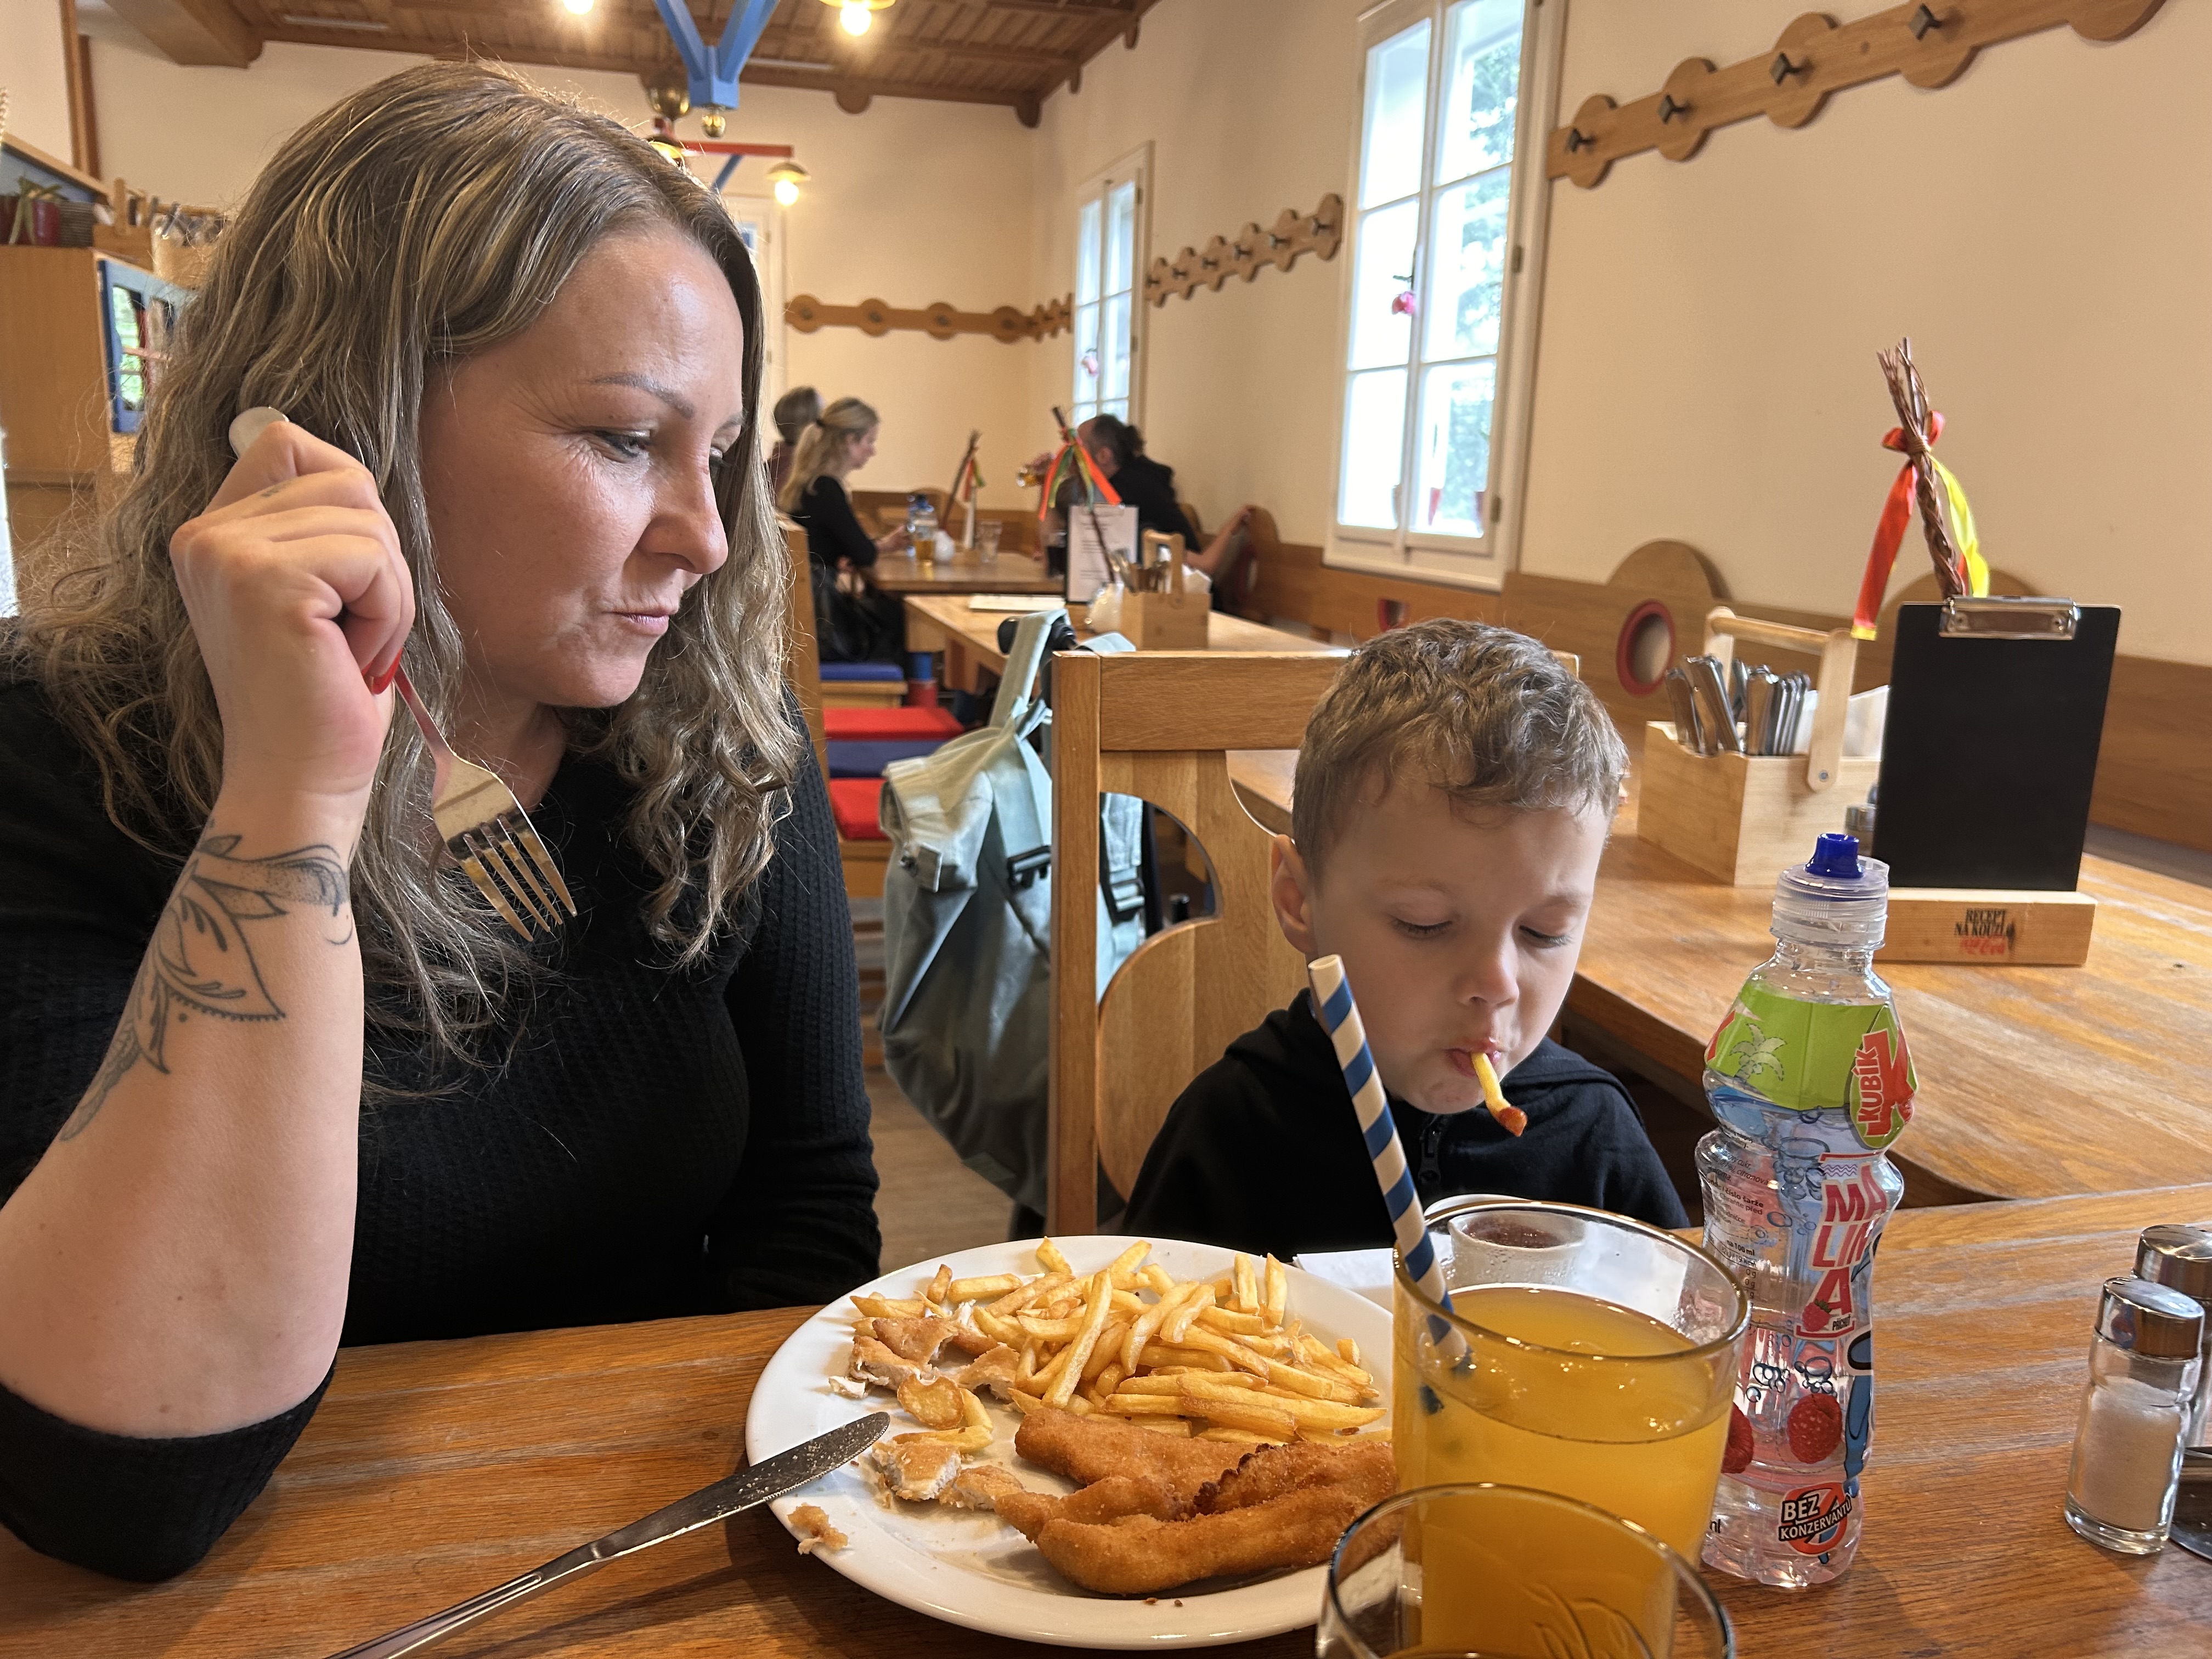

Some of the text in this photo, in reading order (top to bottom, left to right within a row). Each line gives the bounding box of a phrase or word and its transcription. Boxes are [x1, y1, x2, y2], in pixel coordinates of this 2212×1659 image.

[1852, 1047, 1883, 1122] KUBÍK
[1735, 1243, 1745, 1253] 100
[1784, 1496, 1819, 1521] BEZ
